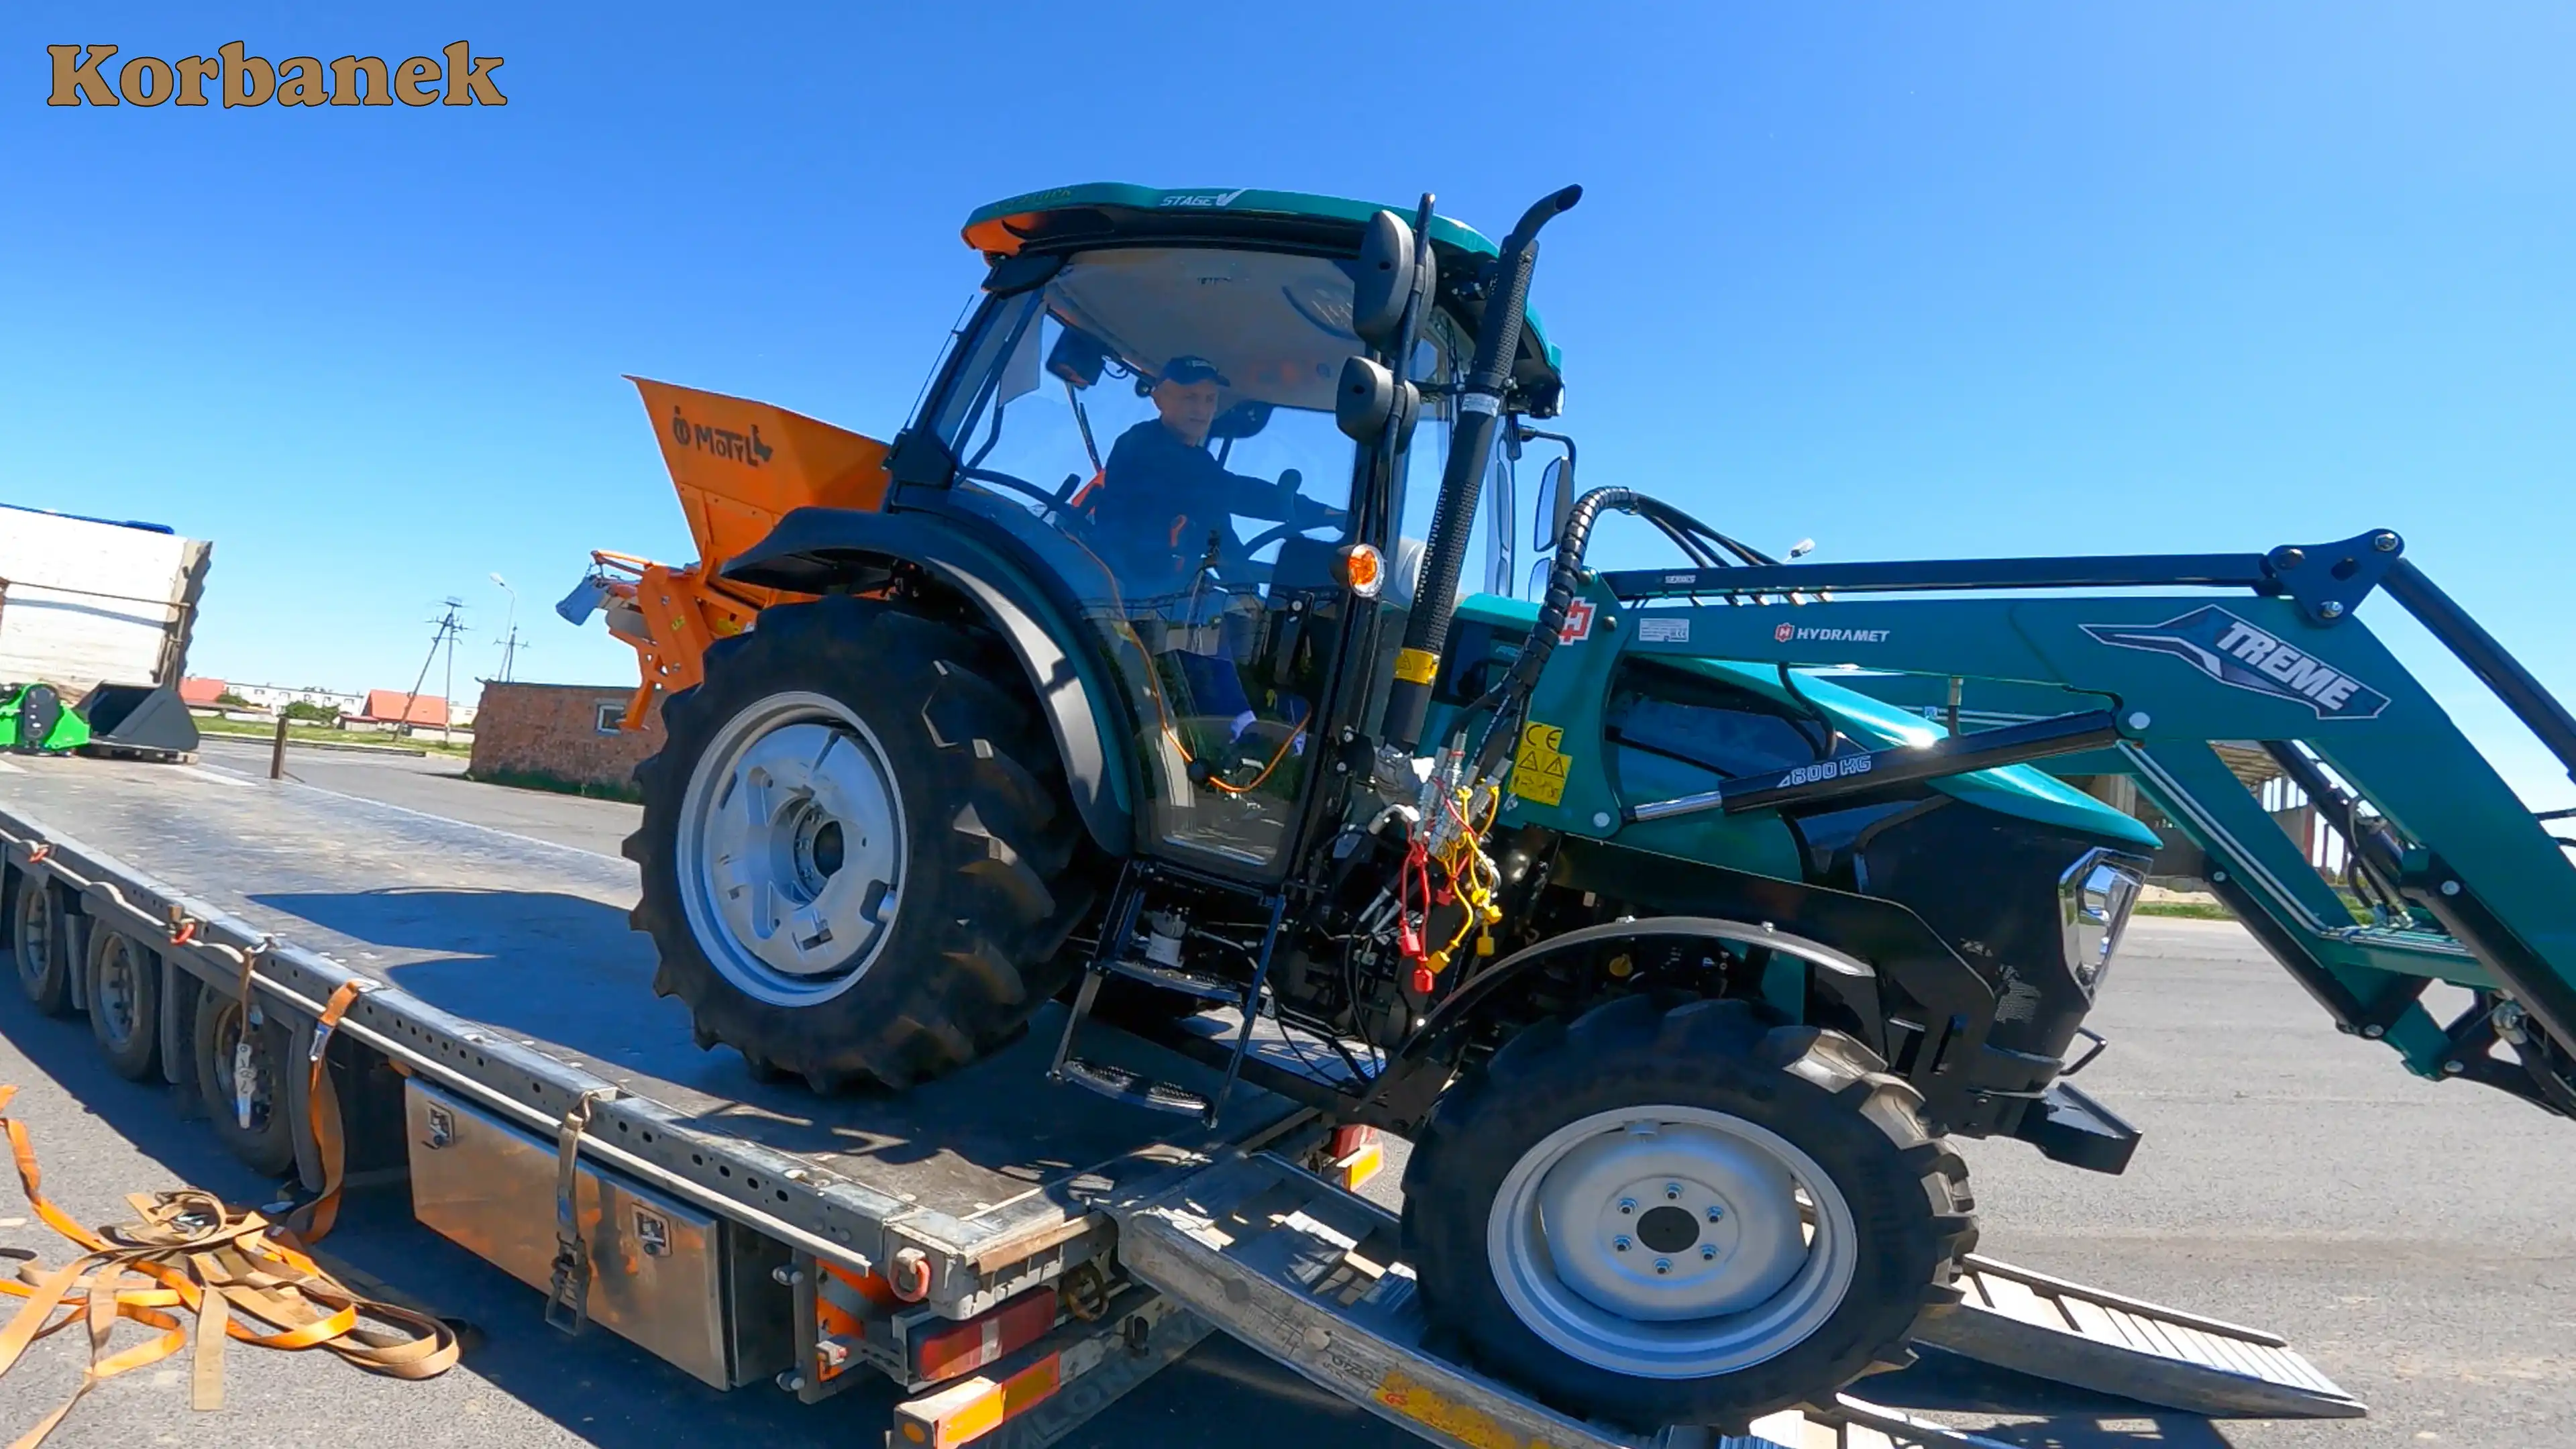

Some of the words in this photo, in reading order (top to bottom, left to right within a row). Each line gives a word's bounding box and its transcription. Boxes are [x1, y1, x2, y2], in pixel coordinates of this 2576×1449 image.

[1159, 195, 1216, 206] STAGE
[1796, 627, 1890, 643] HYDRAMET
[1839, 755, 1872, 775] KG
